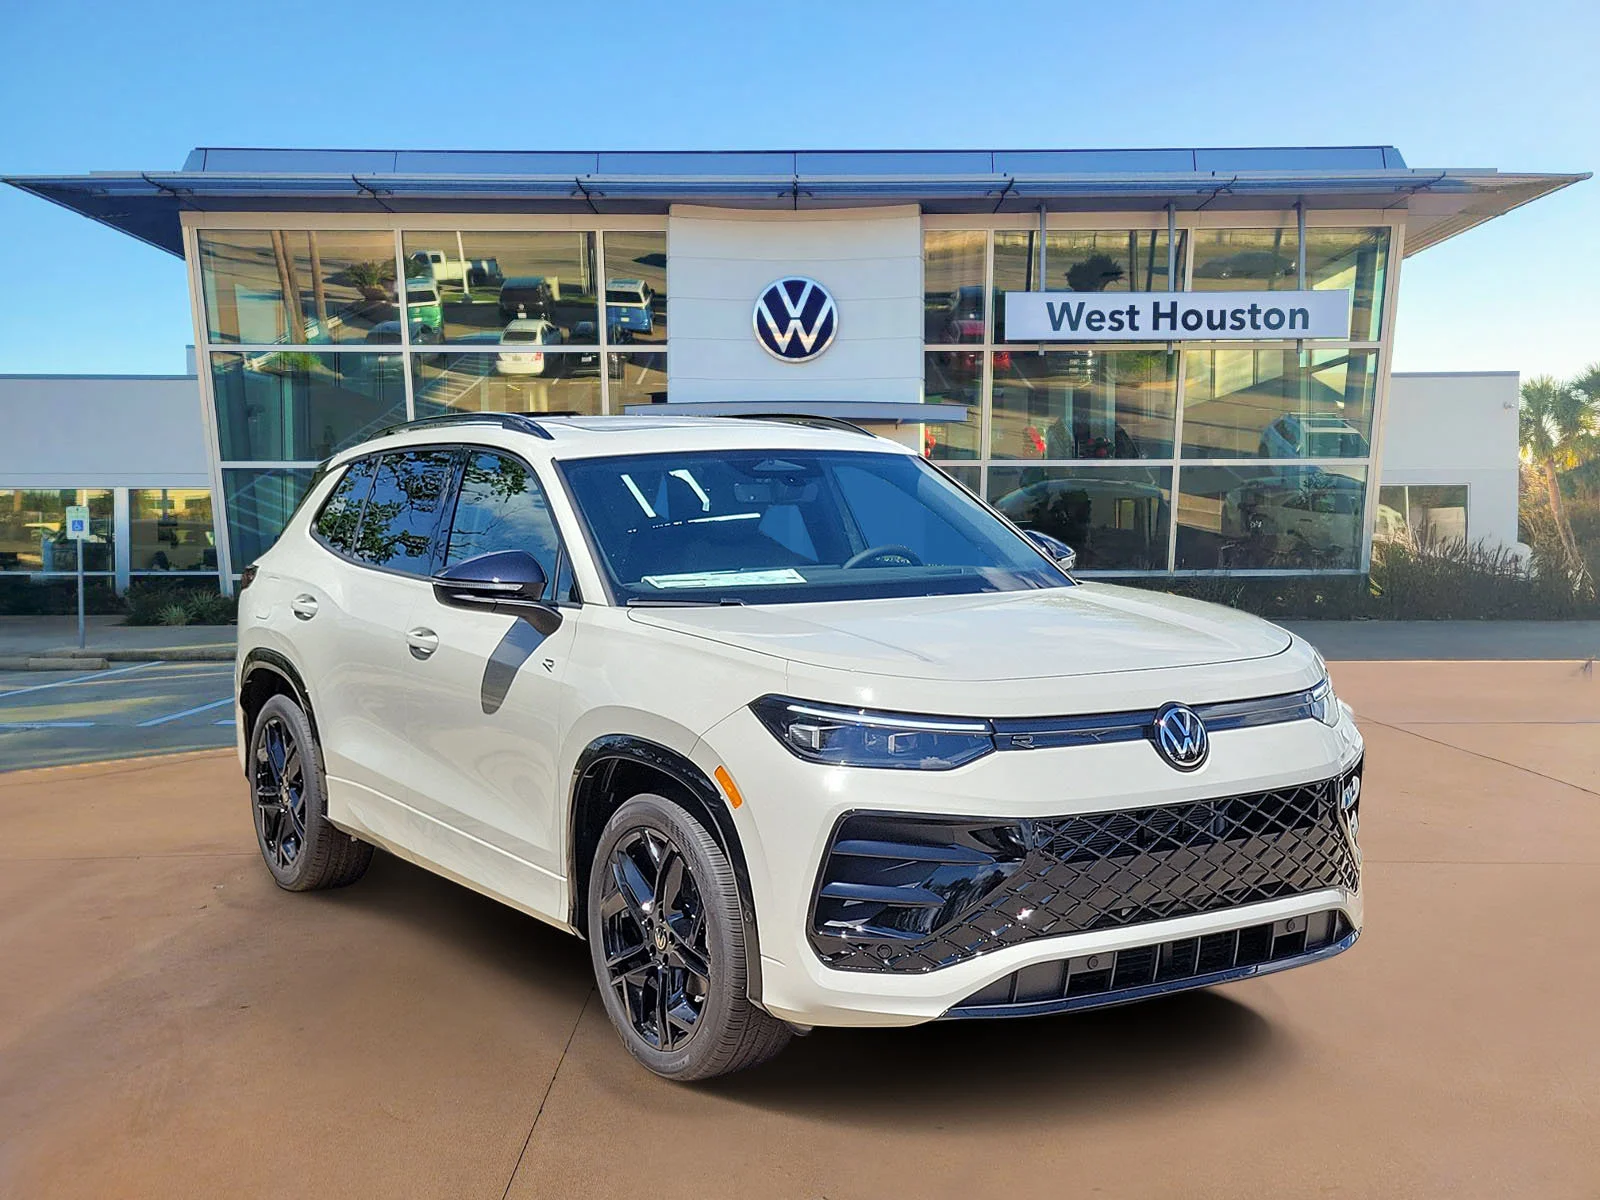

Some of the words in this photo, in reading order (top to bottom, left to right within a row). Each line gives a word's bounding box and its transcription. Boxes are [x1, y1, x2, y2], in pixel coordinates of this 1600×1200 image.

[754, 277, 837, 361] VW
[1046, 301, 1140, 331] West
[1152, 301, 1310, 331] Houston
[1157, 704, 1208, 769] VW
